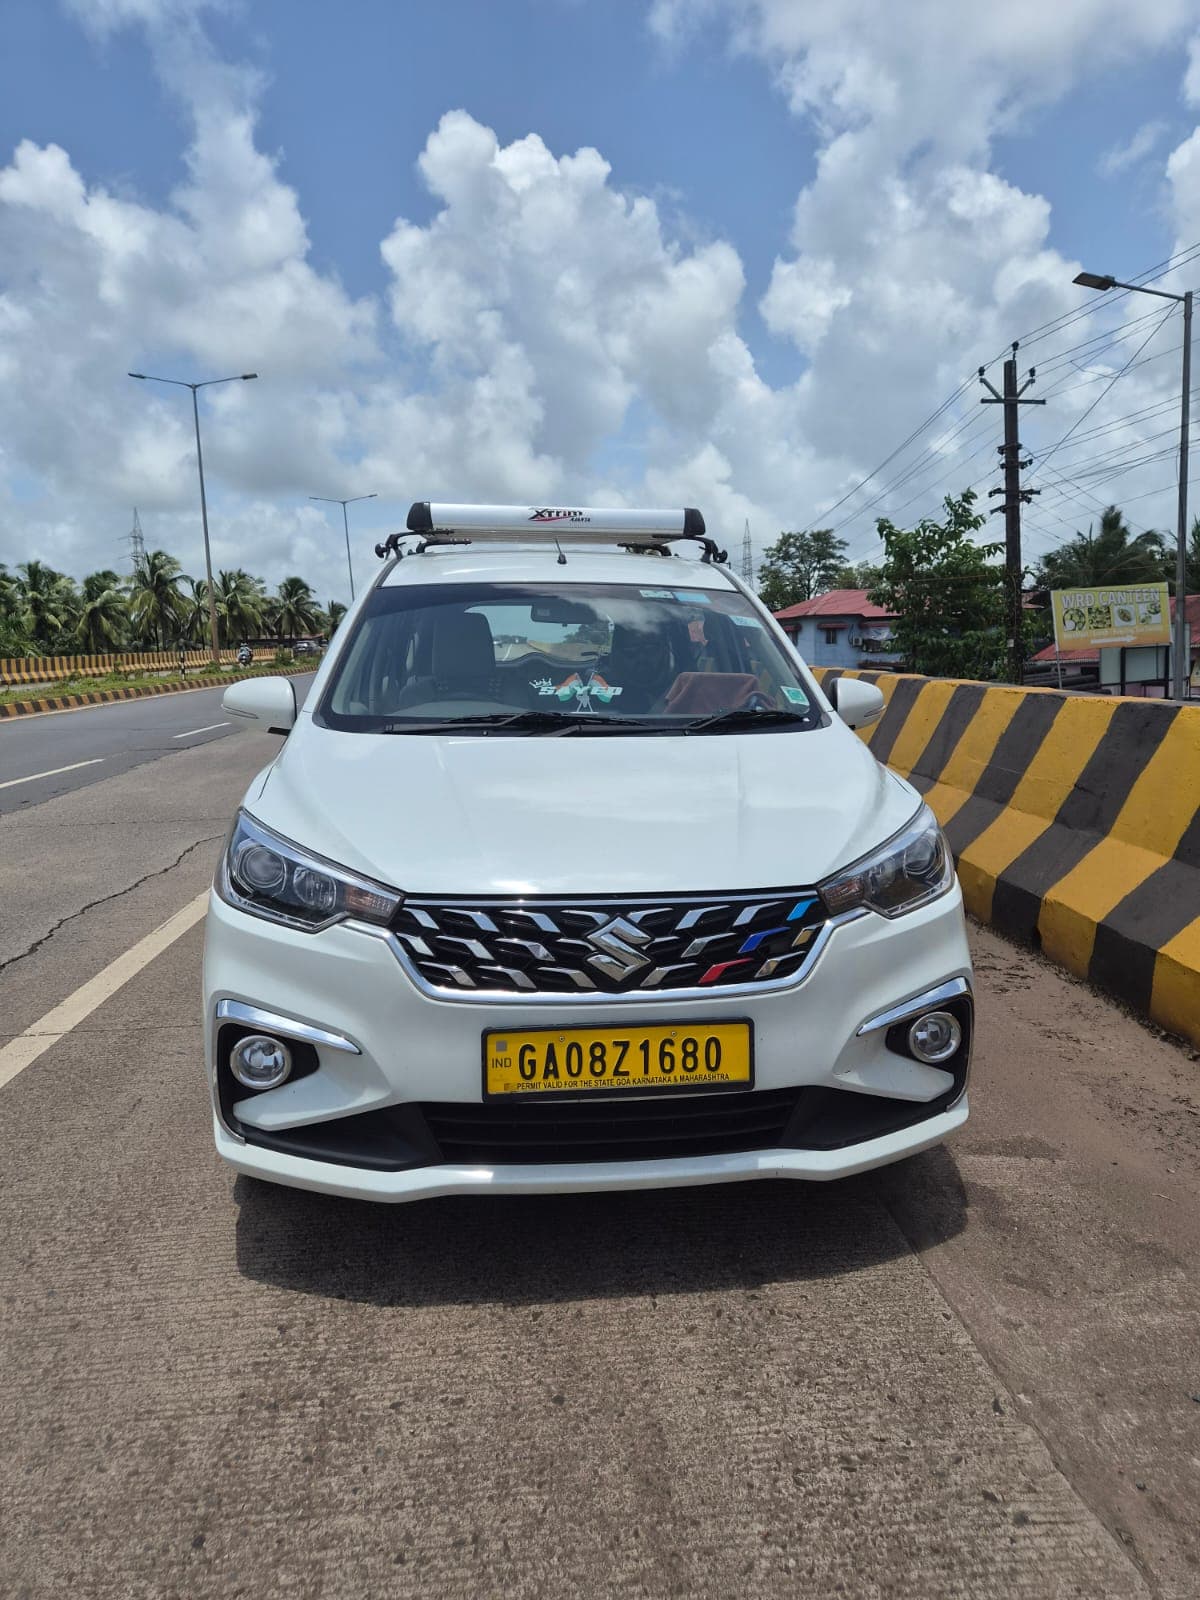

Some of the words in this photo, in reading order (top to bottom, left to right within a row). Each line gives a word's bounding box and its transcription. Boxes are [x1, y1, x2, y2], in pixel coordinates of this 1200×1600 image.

[1062, 592, 1095, 608] WRD
[1099, 588, 1160, 606] CANTEEN
[491, 1057, 512, 1069] IND
[518, 1036, 722, 1081] GA08Z1680
[516, 1081, 541, 1090] PERMIT
[543, 1080, 562, 1089] VALID
[564, 1079, 578, 1088] FOR
[580, 1079, 592, 1088] THE
[594, 1078, 615, 1087] STATE
[616, 1078, 631, 1086] GOA
[632, 1076, 672, 1085] KARNATAKA
[679, 1073, 730, 1081] MAHARASHTRA
